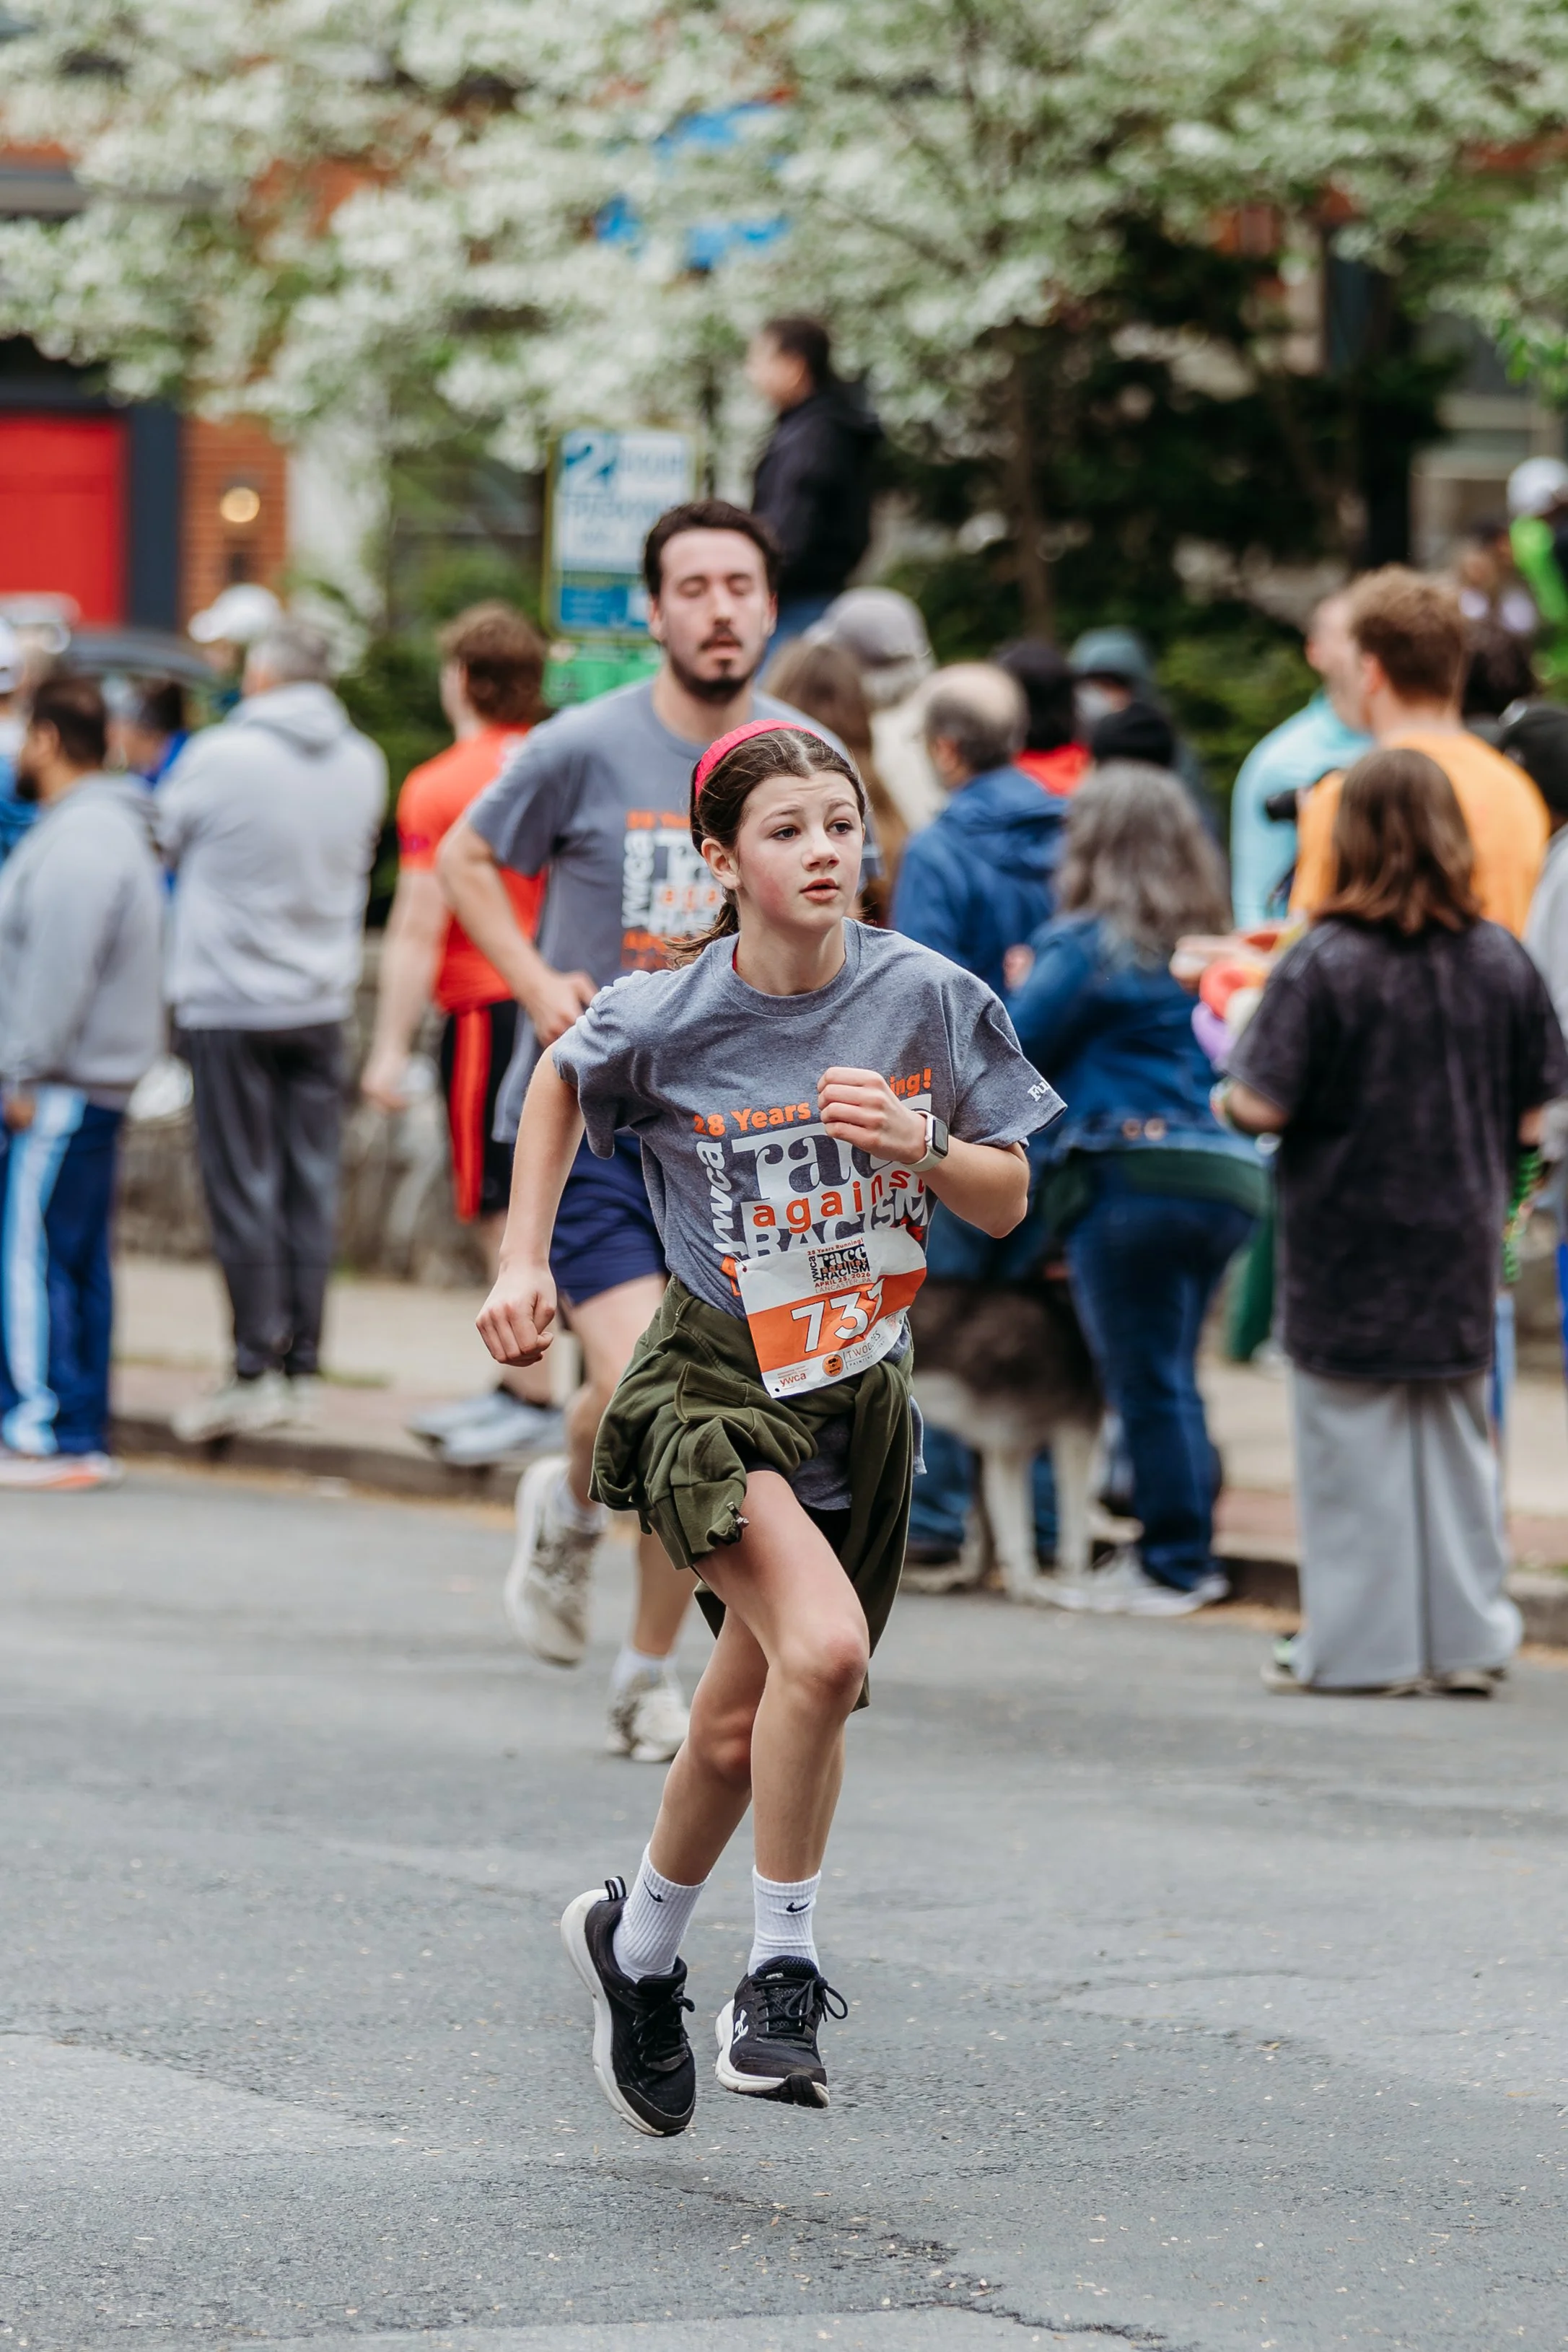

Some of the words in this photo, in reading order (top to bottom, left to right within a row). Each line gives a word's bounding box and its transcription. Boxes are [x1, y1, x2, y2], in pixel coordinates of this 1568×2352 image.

[693, 1114, 727, 1137] 28
[730, 1102, 812, 1132] Years
[696, 1141, 748, 1256] ywca
[817, 1243, 867, 1266] race
[835, 1237, 864, 1249] Running!
[808, 1256, 822, 1282] ywca
[820, 1258, 870, 1282] RACISM
[815, 1279, 837, 1288] APRIL
[779, 1373, 807, 1387] ywca
